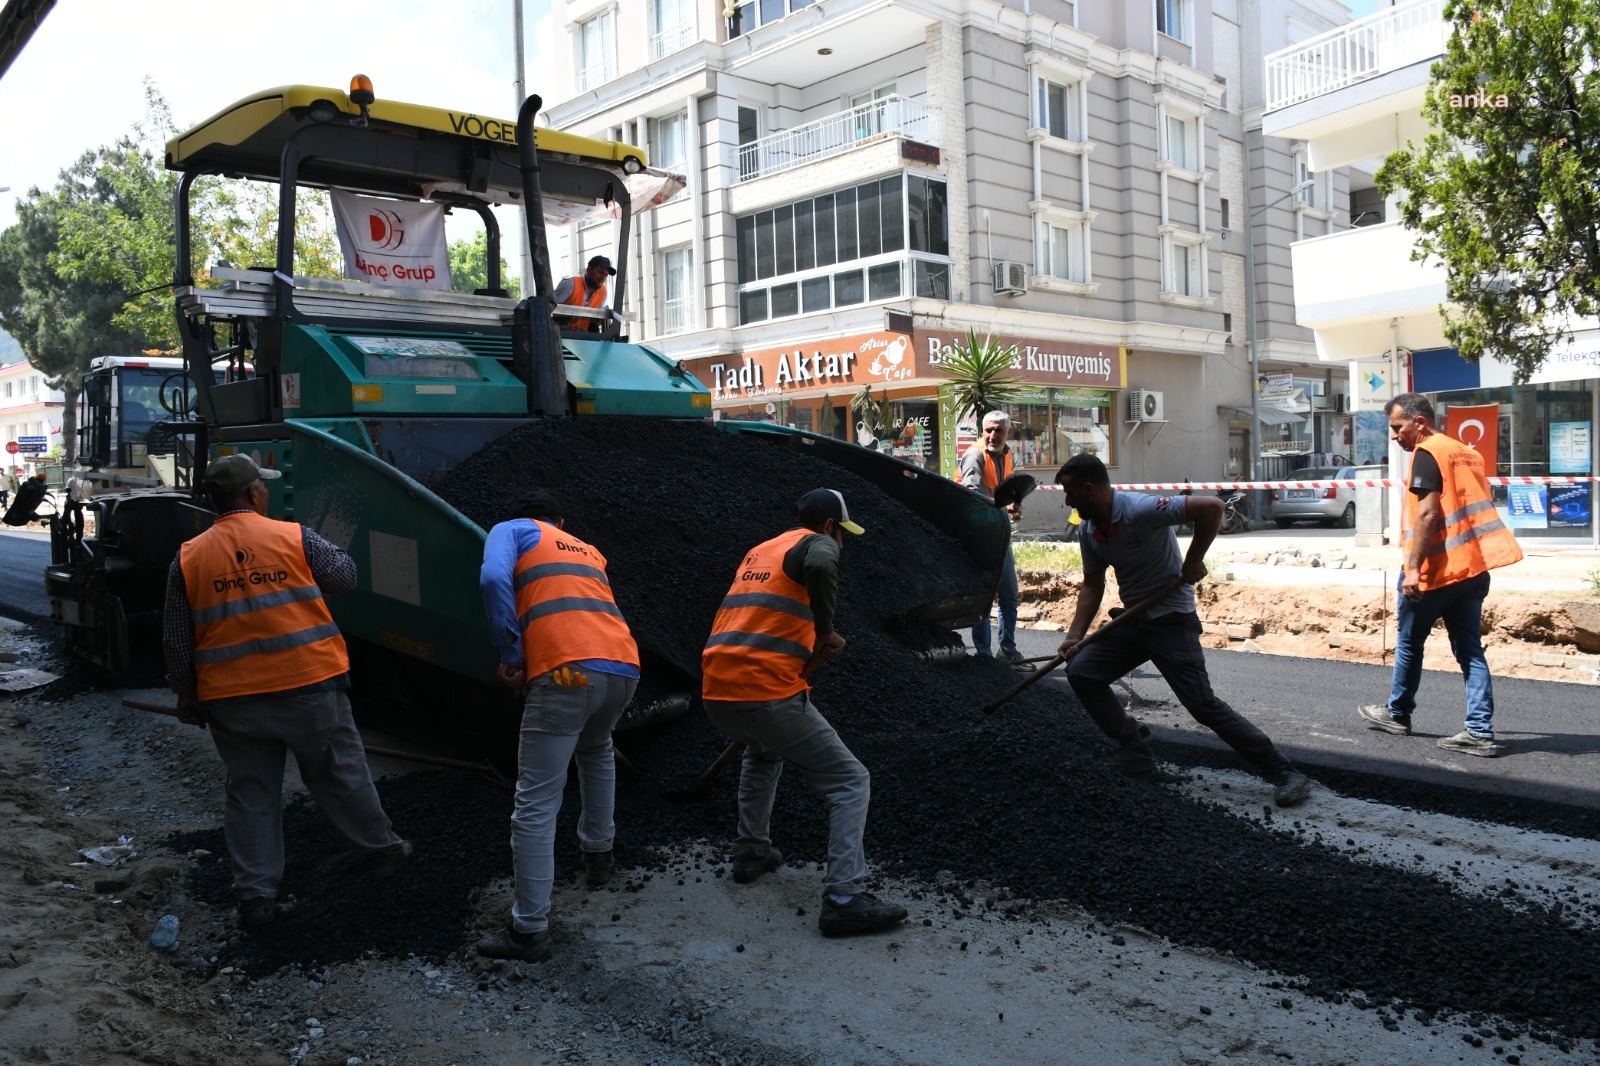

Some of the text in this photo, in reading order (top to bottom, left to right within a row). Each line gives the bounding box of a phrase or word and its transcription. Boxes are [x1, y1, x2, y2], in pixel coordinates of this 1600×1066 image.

[448, 113, 539, 148] VÖGE
[392, 264, 436, 282] Grup
[1026, 345, 1111, 381] Kuruyemiş
[1555, 350, 1600, 363] Teleko
[711, 350, 855, 391] Tadı Aktar
[907, 416, 931, 427] CAFE
[556, 540, 588, 556] Dinç
[213, 570, 288, 593] Dinç Grup
[741, 570, 771, 584] Grup
